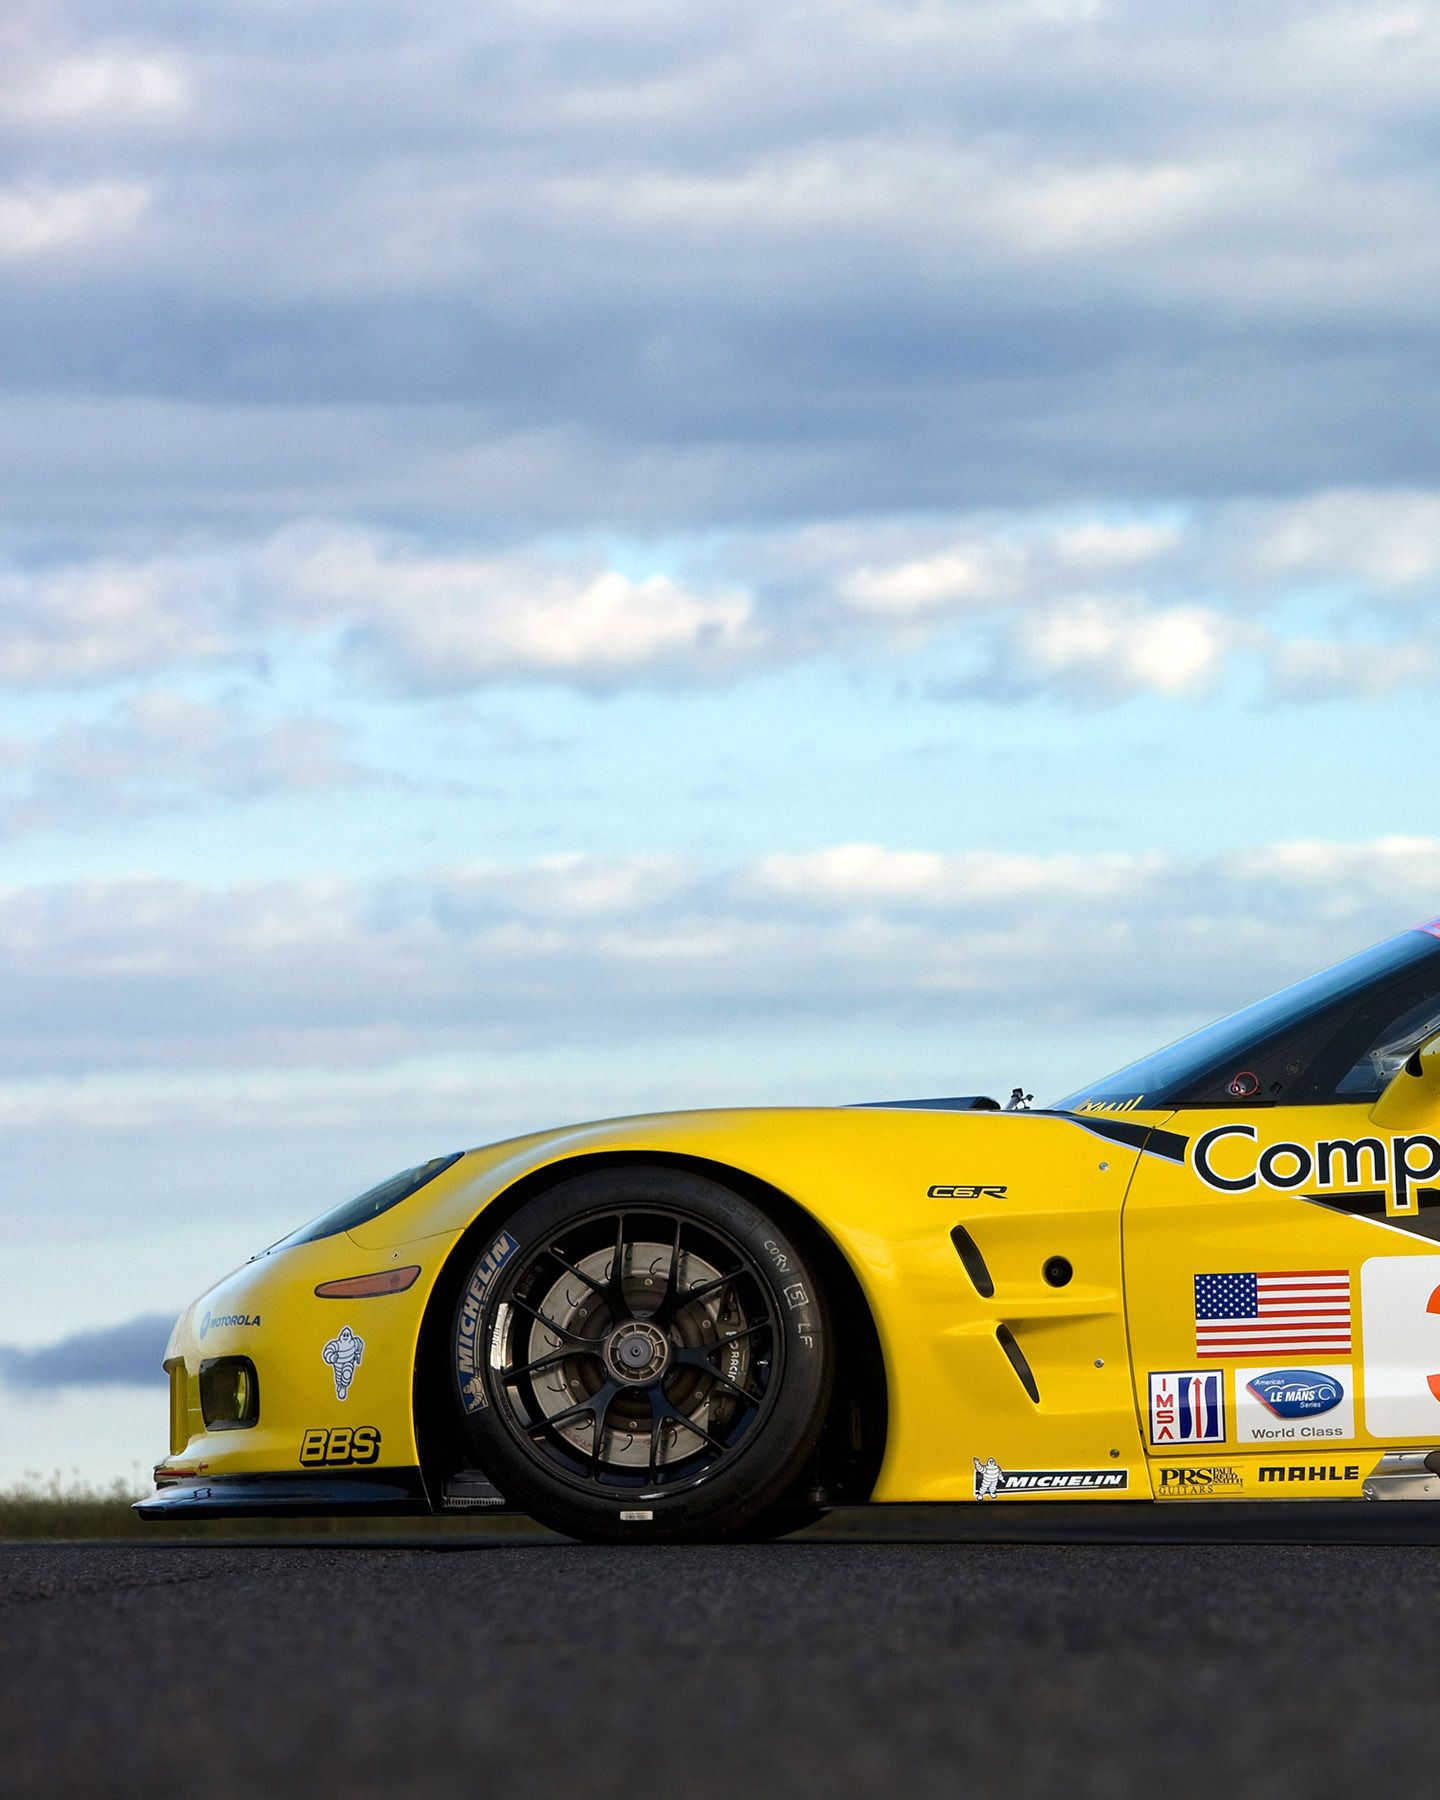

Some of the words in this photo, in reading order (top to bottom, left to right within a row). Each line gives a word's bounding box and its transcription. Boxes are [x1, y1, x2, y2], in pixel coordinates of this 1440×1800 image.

[926, 1184, 1008, 1199] C6.R
[458, 1234, 511, 1375] MICHELIN
[210, 1314, 261, 1329] MOTOROLA
[1254, 1378, 1285, 1386] American
[1270, 1391, 1284, 1402] LE
[1285, 1390, 1316, 1402] MANS
[1299, 1401, 1321, 1409] Series
[1252, 1427, 1295, 1439] World
[1300, 1426, 1344, 1437] Class
[300, 1425, 382, 1467] BBS
[1159, 1469, 1213, 1486] PRS
[1259, 1466, 1359, 1482] MAHLE
[1005, 1475, 1123, 1488] MICHELIN
[1159, 1485, 1214, 1496] GUITARS
